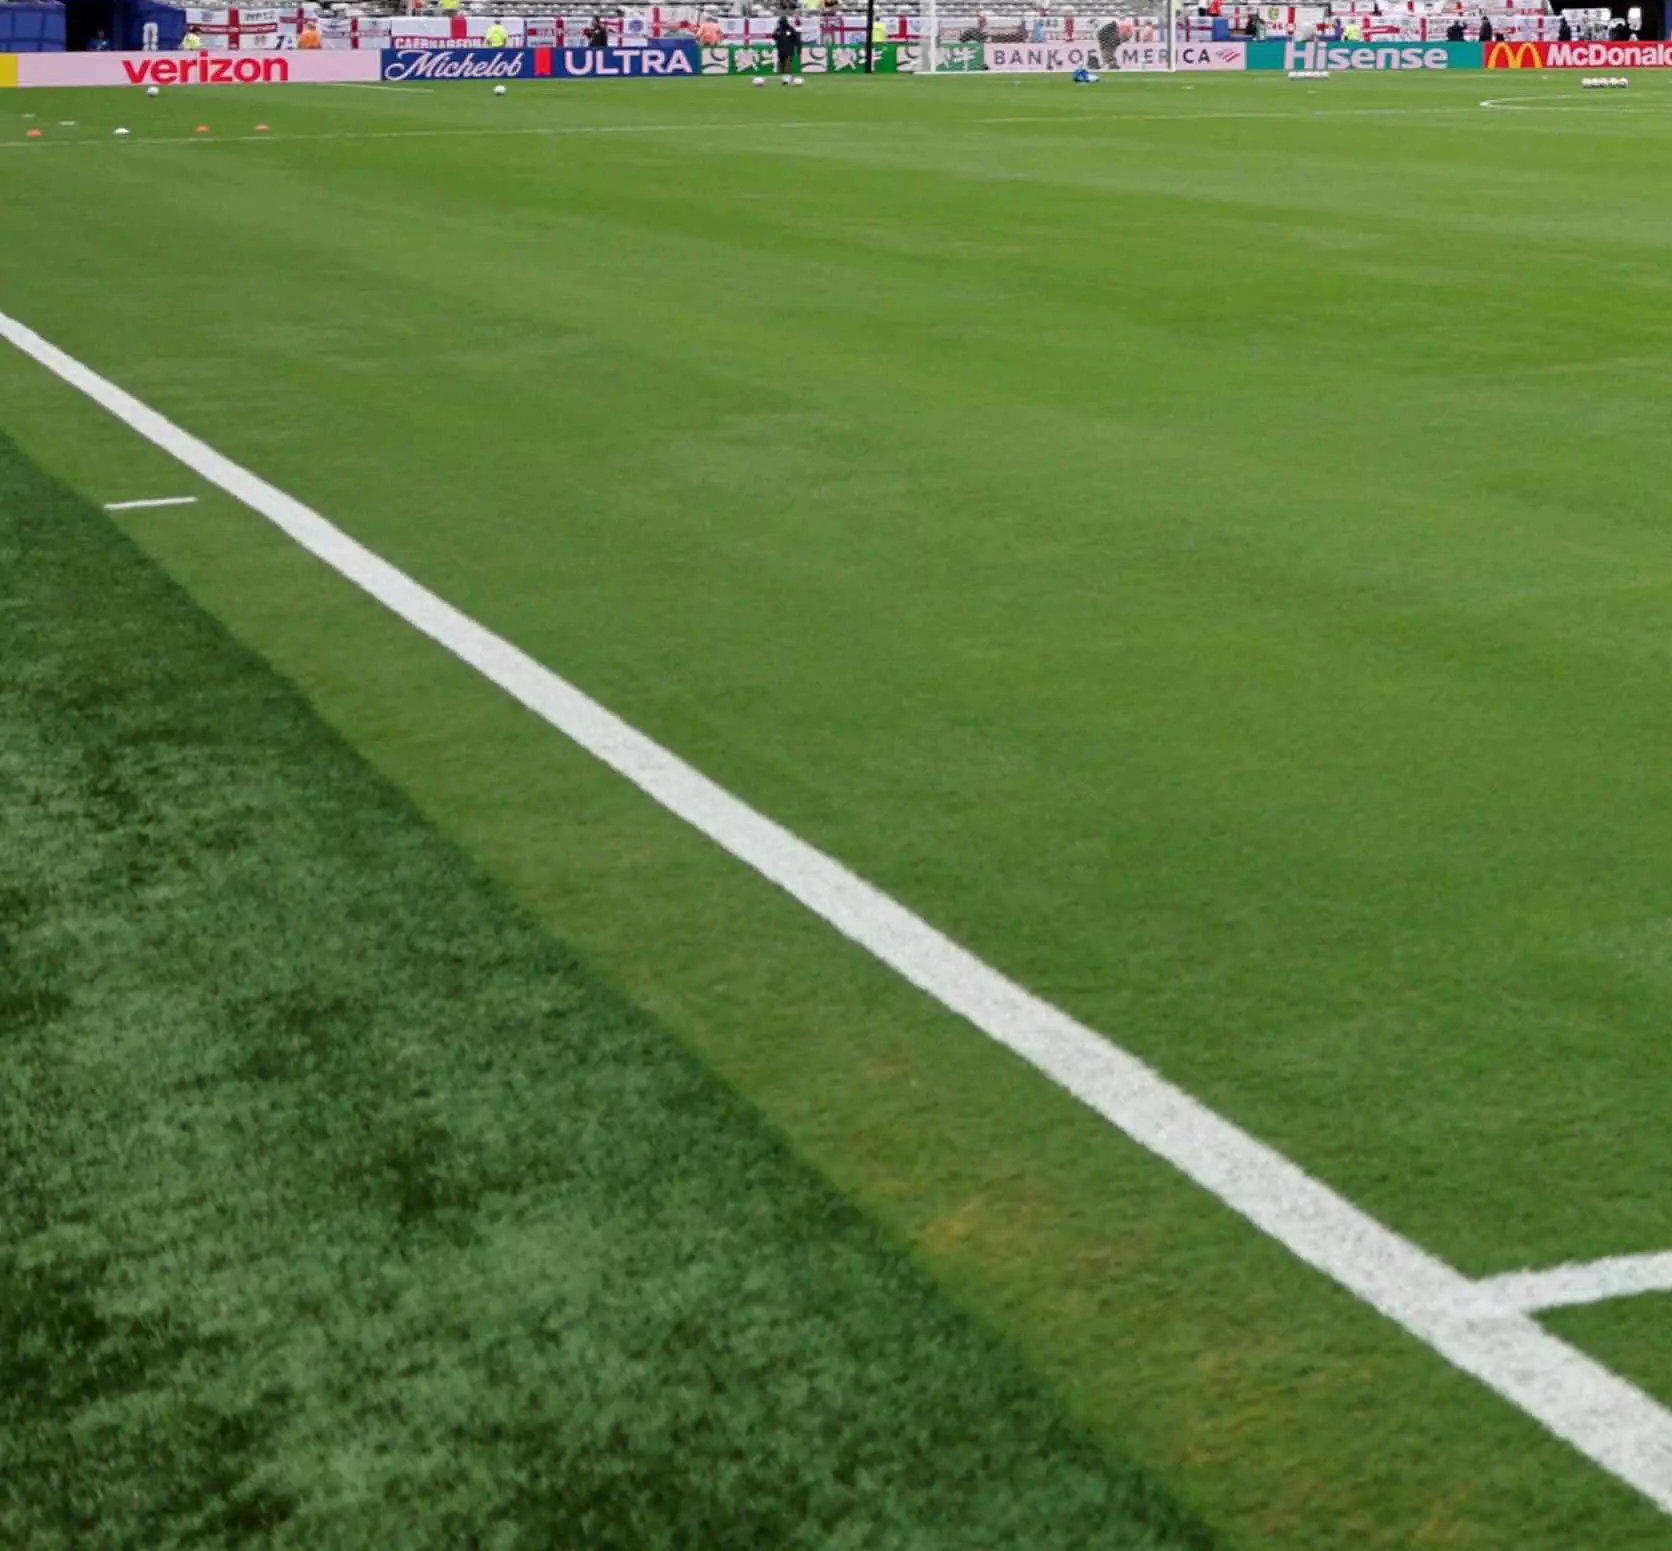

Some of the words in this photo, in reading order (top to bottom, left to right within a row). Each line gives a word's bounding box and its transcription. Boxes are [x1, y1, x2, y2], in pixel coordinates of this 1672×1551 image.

[121, 50, 290, 85] verizon
[385, 49, 524, 80] Michelob
[564, 50, 692, 74] ULTRA
[994, 50, 1062, 65] BANK
[1070, 50, 1098, 65] OF
[1106, 49, 1211, 65] MERICA
[1284, 40, 1448, 70] Hisense
